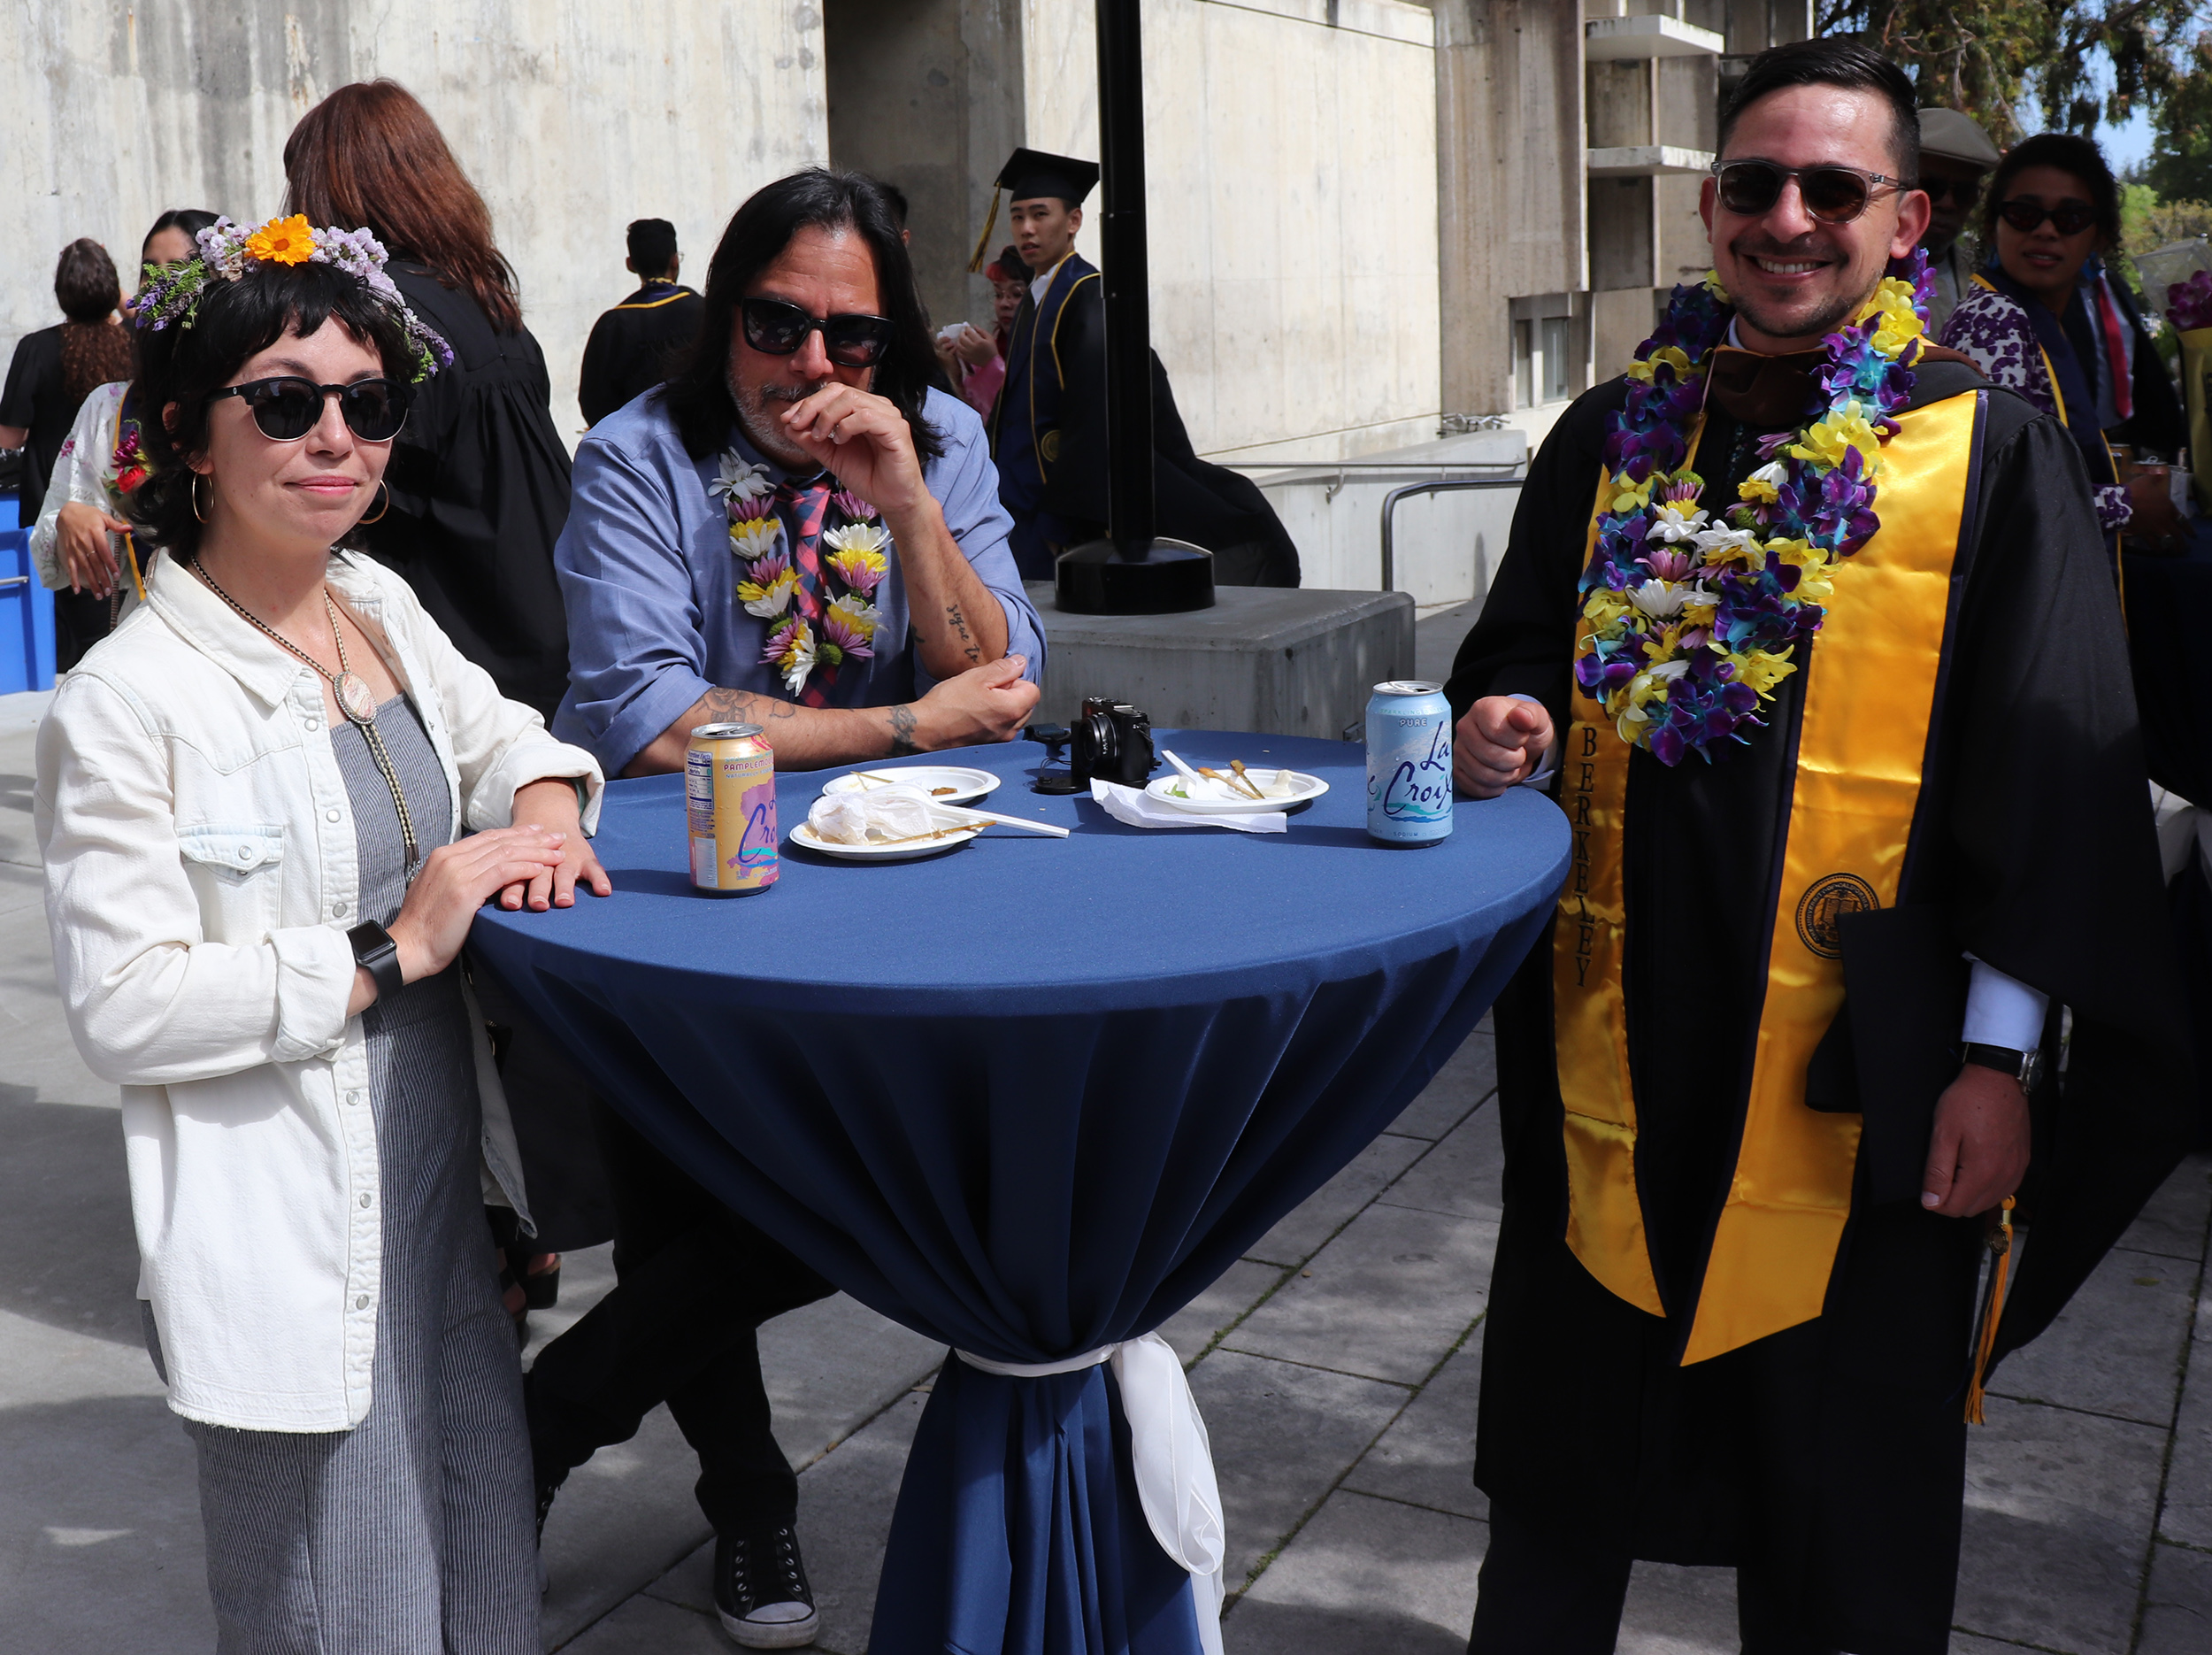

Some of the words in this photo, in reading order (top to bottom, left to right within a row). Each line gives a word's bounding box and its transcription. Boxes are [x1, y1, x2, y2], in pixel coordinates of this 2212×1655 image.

[1399, 718, 1427, 727] PURE
[1419, 720, 1450, 771] La
[1383, 760, 1453, 815] Croix
[738, 803, 776, 863] Cro
[1575, 727, 1597, 988] BERKELEY
